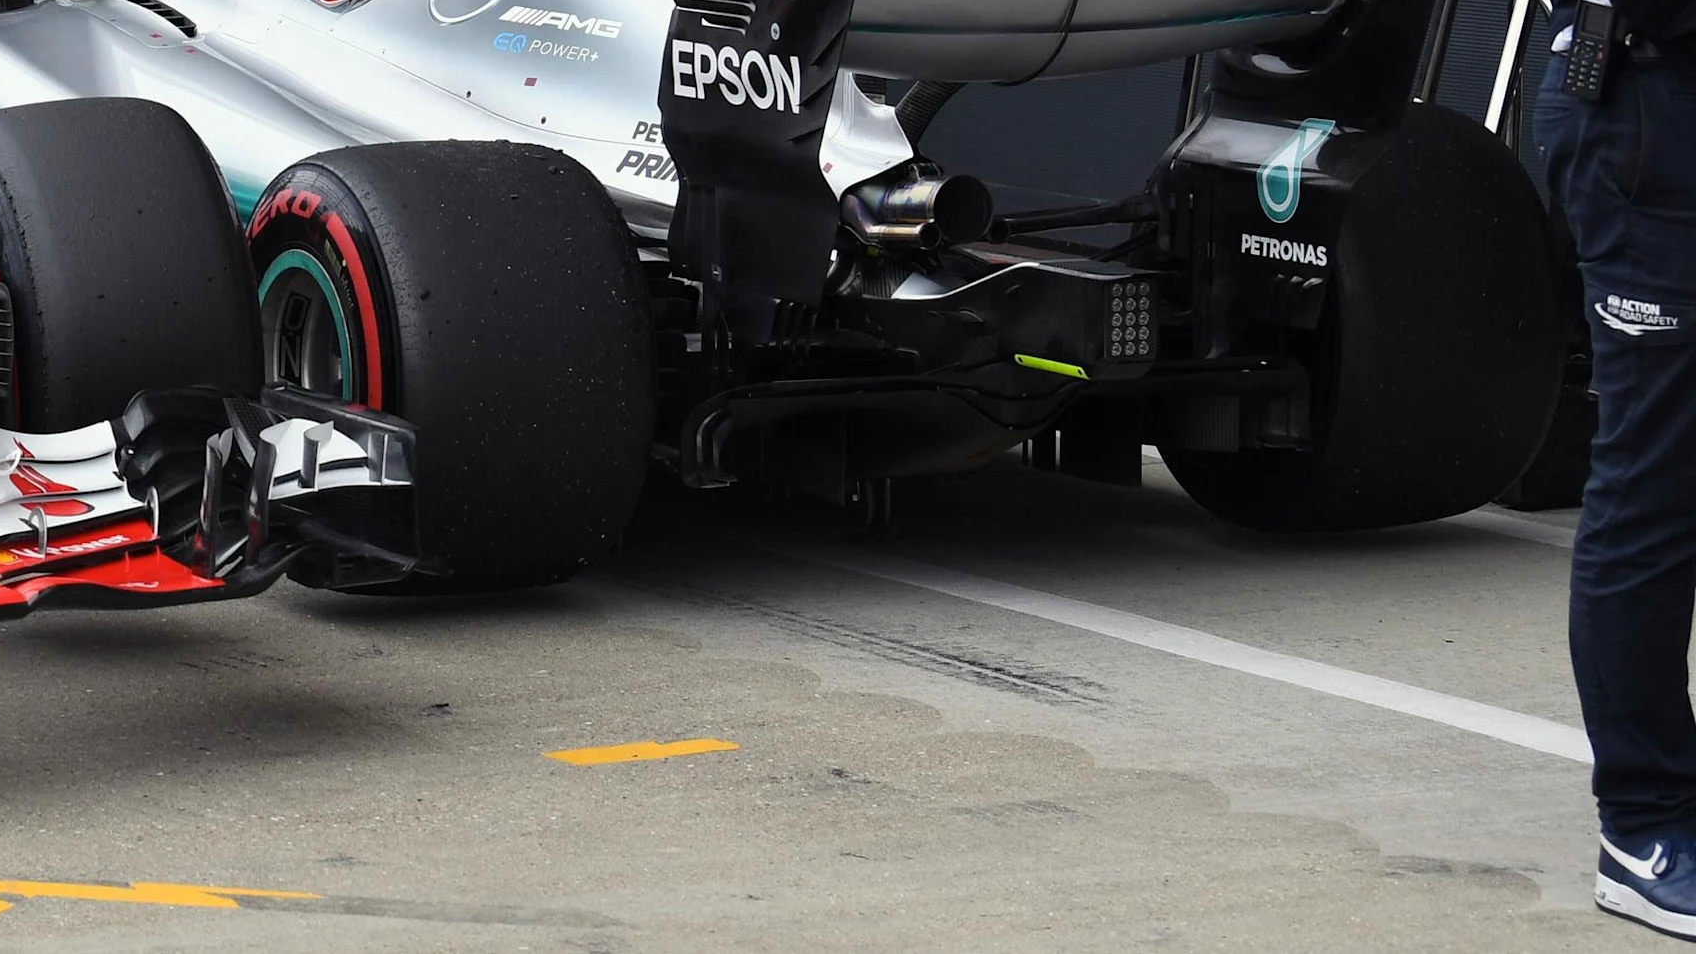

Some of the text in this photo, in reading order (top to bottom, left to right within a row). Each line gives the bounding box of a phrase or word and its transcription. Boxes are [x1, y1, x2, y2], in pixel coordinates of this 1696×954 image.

[535, 10, 623, 39] AMG
[494, 32, 599, 62] EQ POWER+
[672, 39, 800, 115] EPSON
[632, 120, 665, 144] PE
[1240, 233, 1328, 267] PETRONAS
[1619, 309, 1642, 322] ROAD
[1642, 314, 1679, 326] SAFETY
[1621, 298, 1660, 316] ACTION
